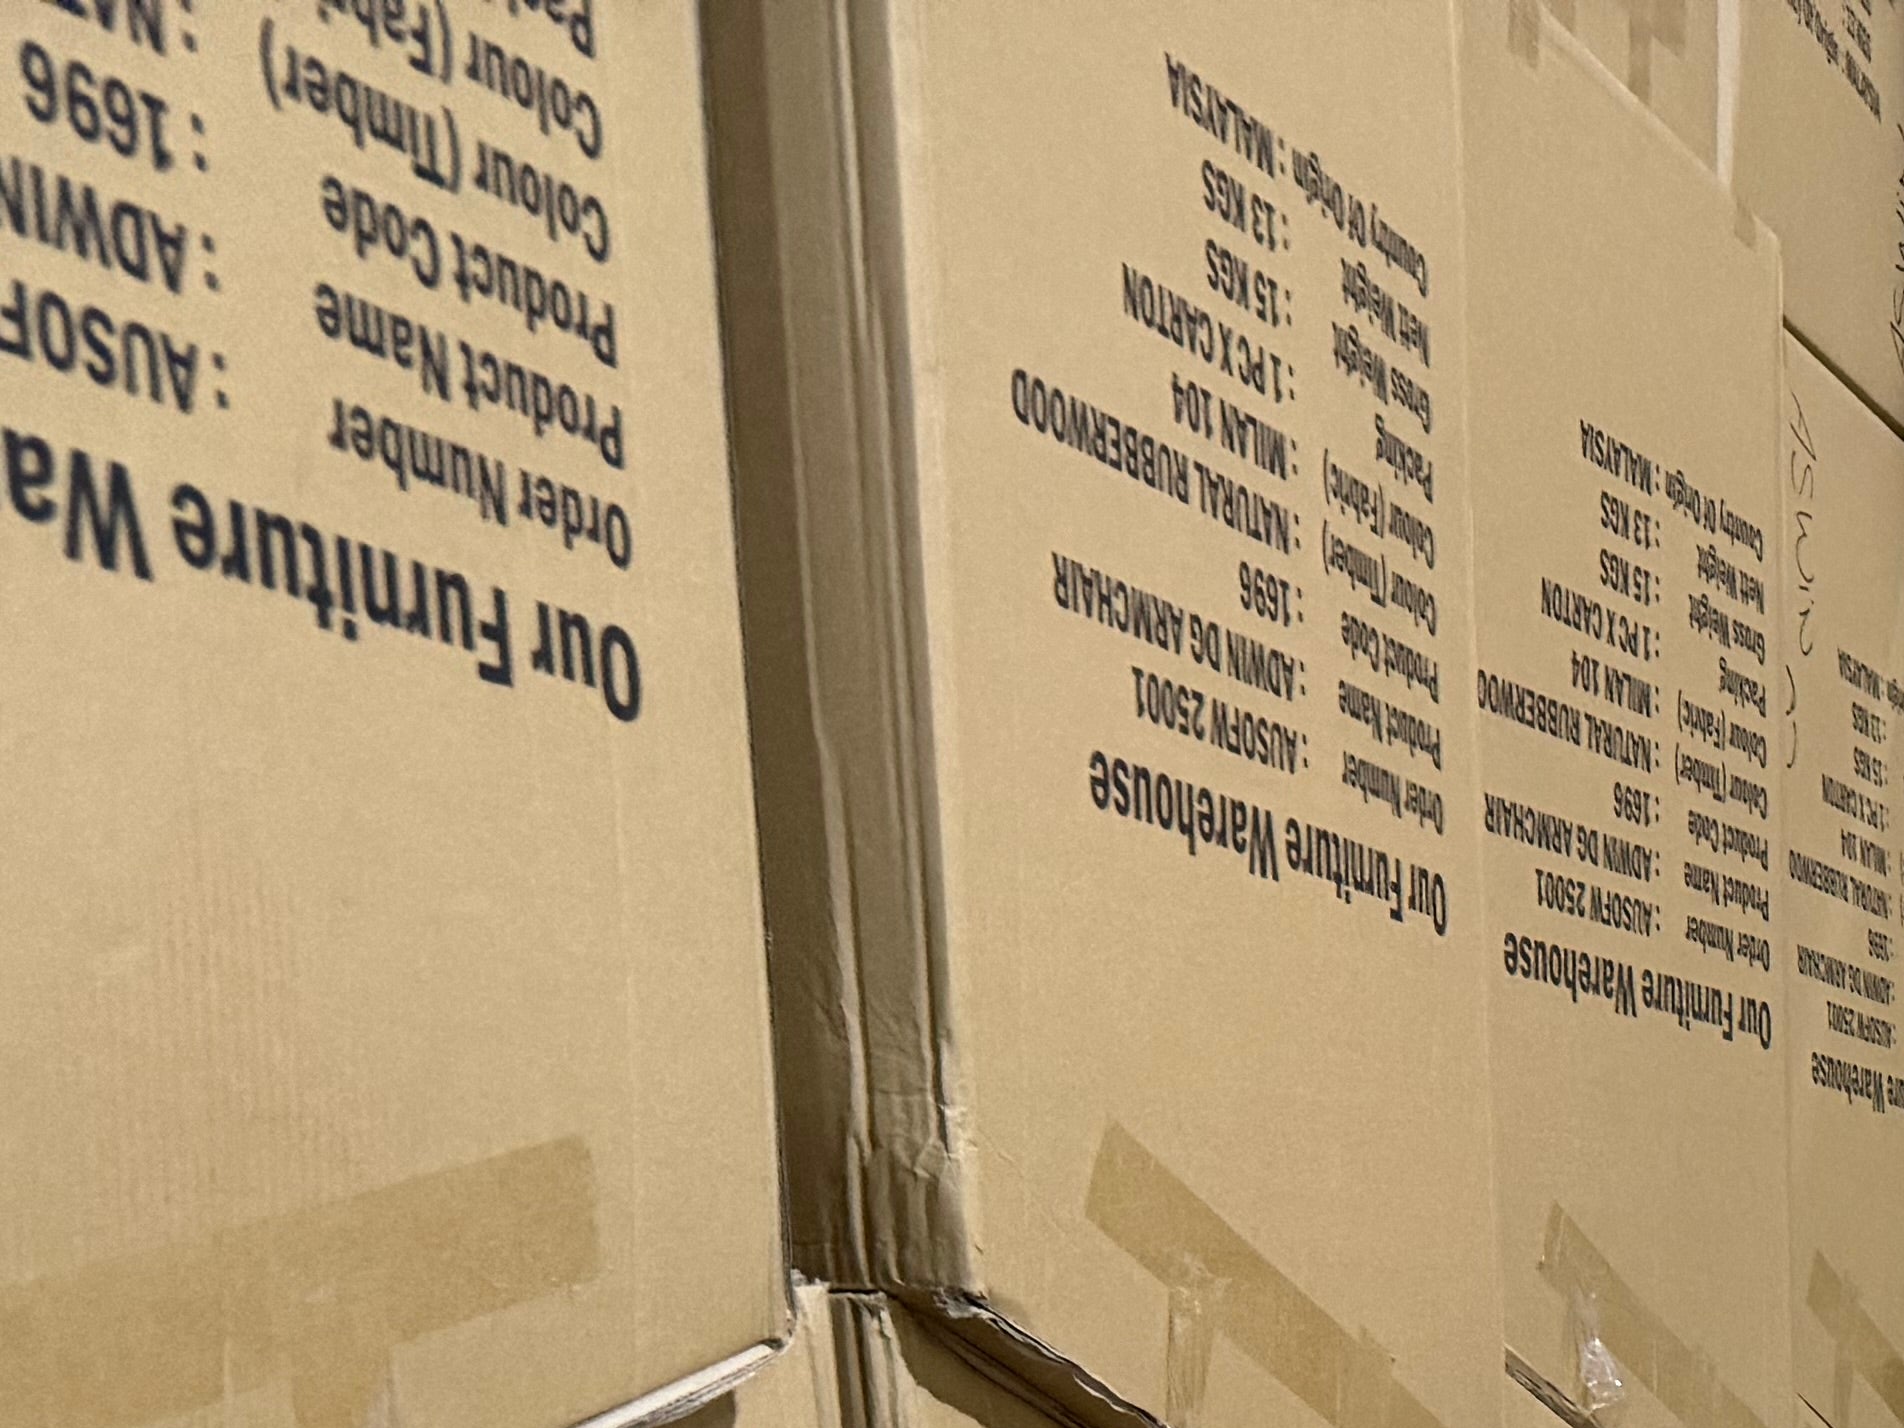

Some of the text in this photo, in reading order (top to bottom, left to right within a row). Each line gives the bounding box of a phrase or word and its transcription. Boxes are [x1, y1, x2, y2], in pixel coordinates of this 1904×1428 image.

[18, 39, 174, 173] 1696
[257, 16, 462, 195] (Timber)
[1164, 51, 1275, 179] MALAYSIA
[320, 174, 442, 290] Code
[471, 139, 611, 265] Colour
[1290, 147, 1346, 232] Origin
[0, 278, 199, 415] AUSOF
[313, 281, 452, 403] Name
[448, 230, 618, 369] Product
[326, 397, 508, 527] Number
[457, 338, 625, 471] Product
[1010, 367, 1190, 505] RUBBERWOOD
[516, 467, 632, 571] Order
[1192, 459, 1290, 555] NATURAL
[169, 482, 514, 689] Furniture
[529, 600, 642, 723] Our
[1088, 749, 1448, 937] Our Furniture Warehouse
